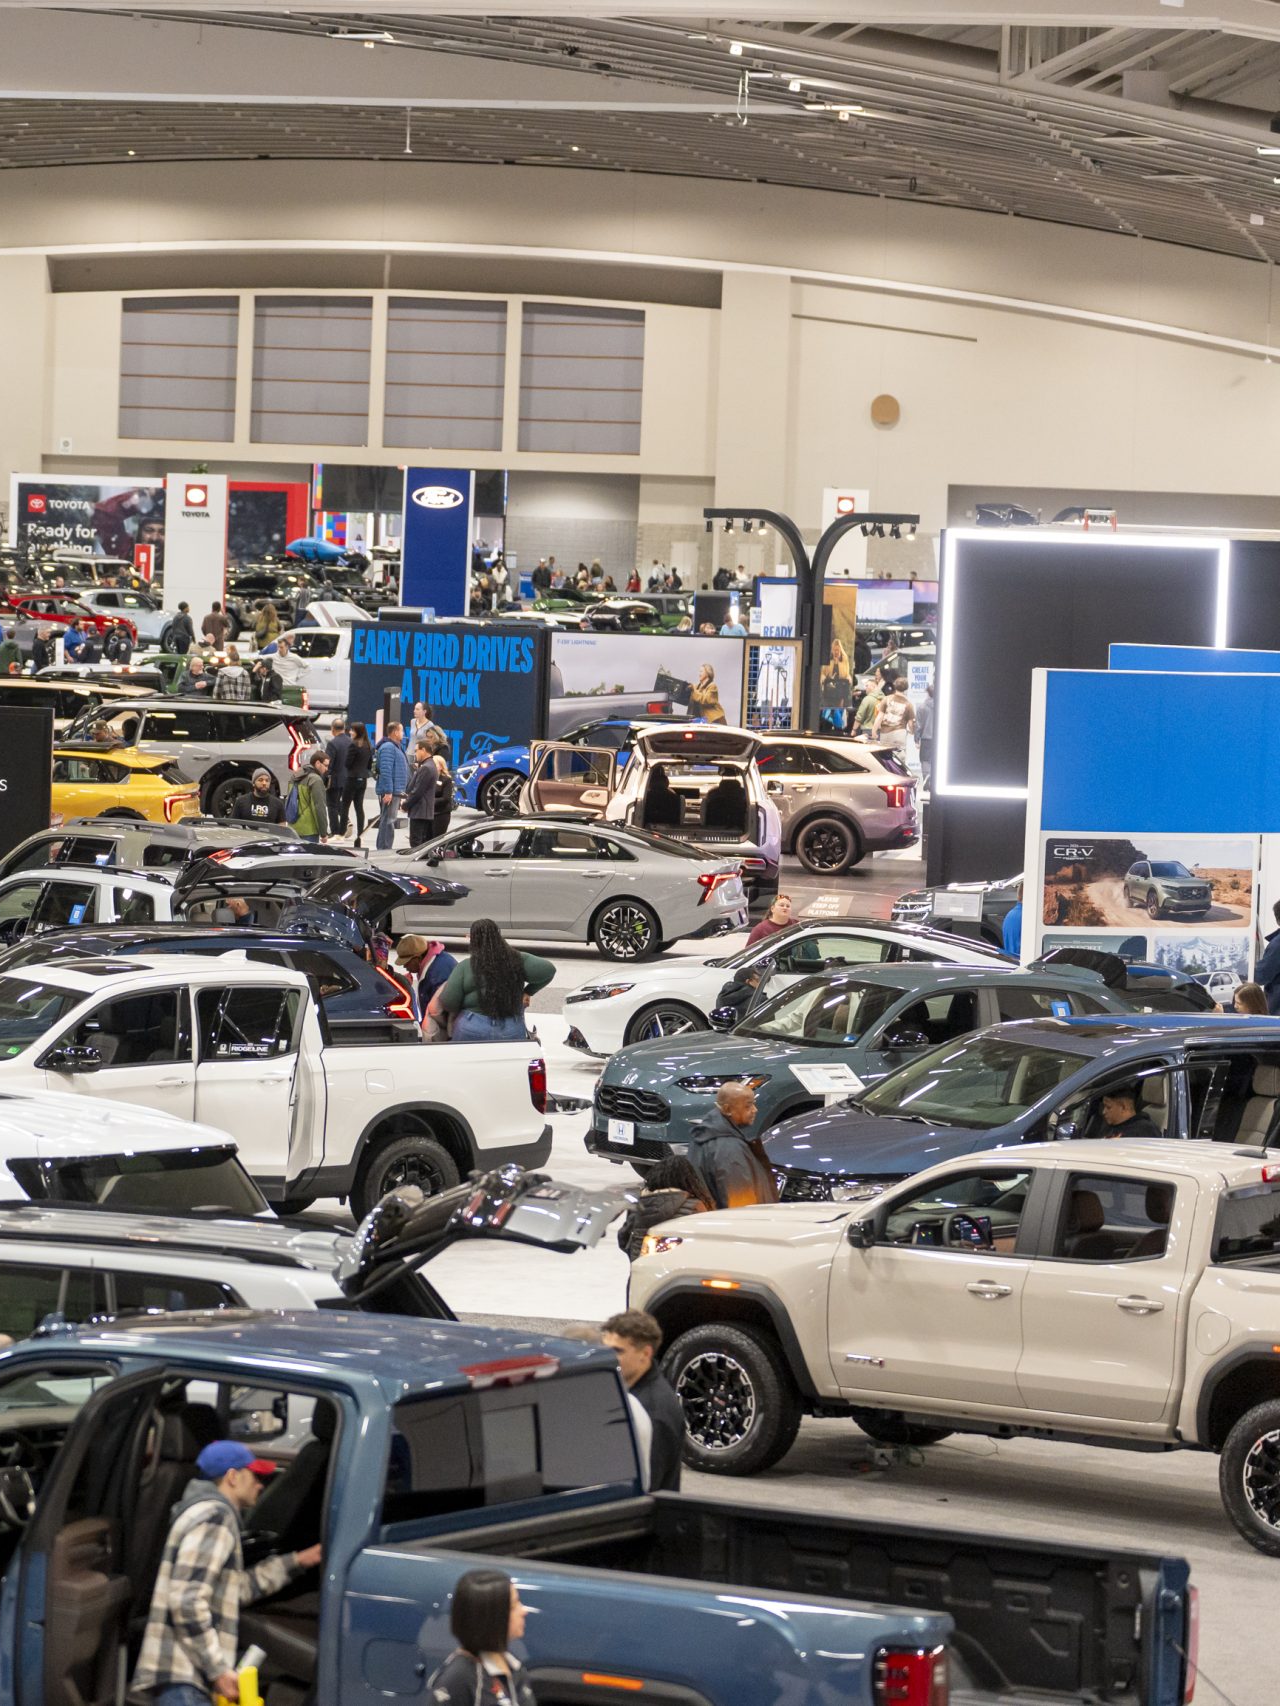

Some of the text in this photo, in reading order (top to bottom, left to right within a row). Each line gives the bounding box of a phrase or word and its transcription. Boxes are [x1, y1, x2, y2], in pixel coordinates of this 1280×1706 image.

[49, 499, 91, 510] TOYOTA
[75, 522, 97, 539] for
[353, 628, 535, 674] EARLY BIRD DRIVES
[400, 668, 481, 708] A TRUCK
[1053, 847, 1094, 857] CR-V
